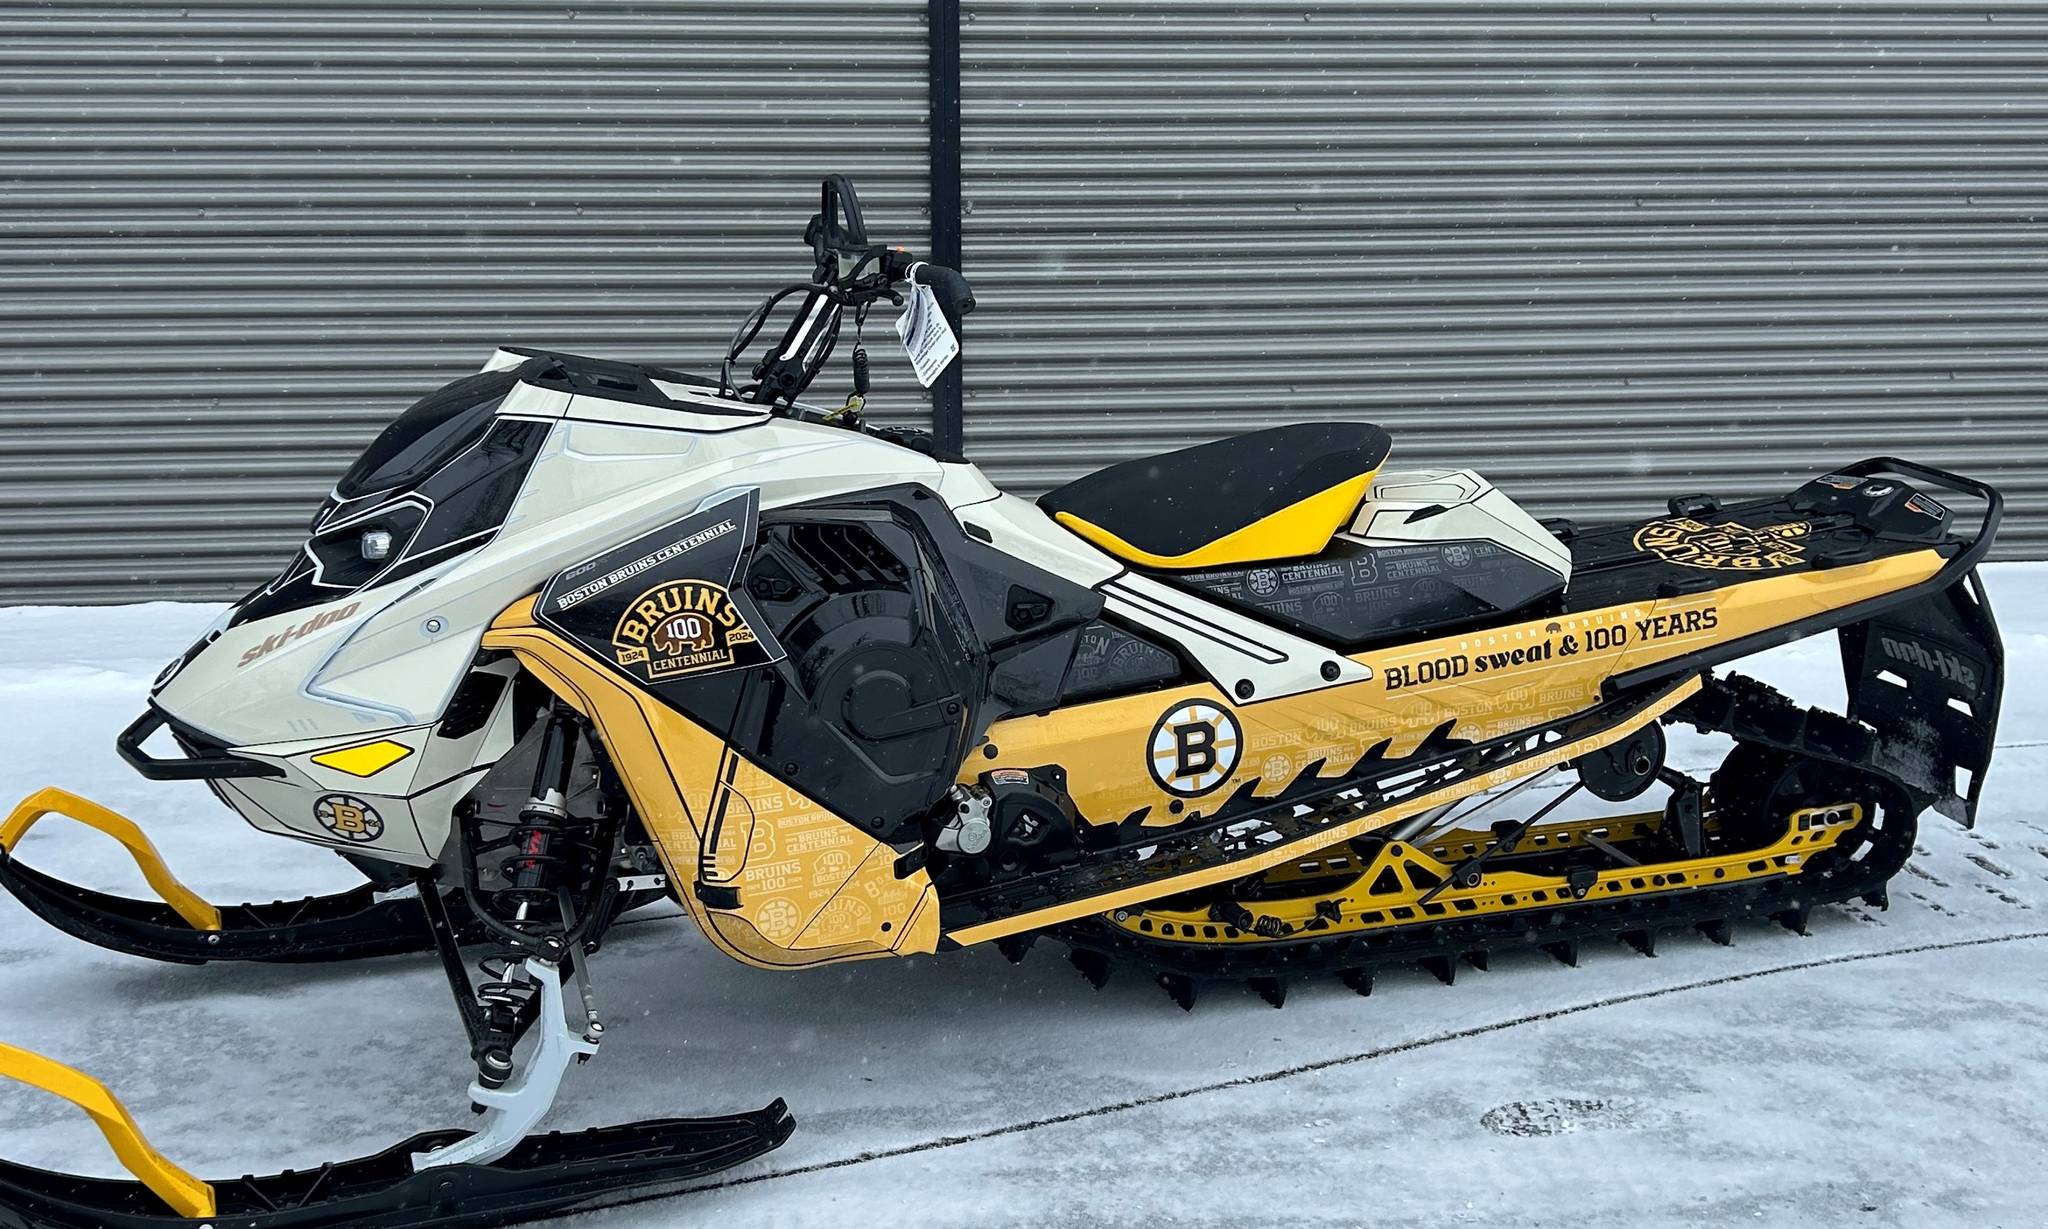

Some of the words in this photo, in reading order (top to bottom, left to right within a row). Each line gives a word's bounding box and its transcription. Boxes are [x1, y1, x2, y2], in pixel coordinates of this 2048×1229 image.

[557, 577, 609, 610] BOSTON
[608, 555, 658, 582] BRUINS
[656, 521, 736, 561] CENTENNIAL
[1281, 565, 1345, 582] CENTENNIAL
[1386, 565, 1441, 579] CENTENNIAL
[1397, 560, 1430, 571] BRUINS
[1321, 595, 1338, 607] 100
[1355, 588, 1401, 604] BRUINS
[622, 586, 736, 644] BRUINS
[237, 600, 363, 668] ski-doo
[667, 618, 702, 639] 100
[728, 631, 754, 642] 2024
[1460, 627, 1537, 651] BOSTON
[1567, 608, 1641, 630] BRUINS
[621, 651, 645, 662] 1924
[1384, 654, 1469, 691] BLOOD
[1474, 637, 1553, 673] sweat
[1558, 634, 1579, 657] &
[1584, 624, 1627, 653] 100
[1635, 606, 1719, 642] YEARS
[652, 649, 728, 671] CENTENNIAL
[1506, 687, 1529, 701] 100
[1540, 686, 1584, 701] BRUINS
[1410, 700, 1433, 715] 100
[1444, 702, 1492, 719] BOSTON
[1315, 716, 1341, 731] 100
[1350, 715, 1395, 733] BRUINS
[1497, 716, 1532, 729] BRUINS
[1252, 732, 1301, 749] BOSTON
[1173, 721, 1217, 778] B
[1307, 746, 1342, 759] BRUINS
[331, 803, 366, 834] B
[786, 834, 853, 853] CENTENNIAL
[798, 829, 839, 842] BRUINS
[1303, 828, 1349, 846] BRUINS
[822, 852, 845, 866] 100
[745, 861, 801, 882] BRUINS
[761, 876, 786, 891] 100
